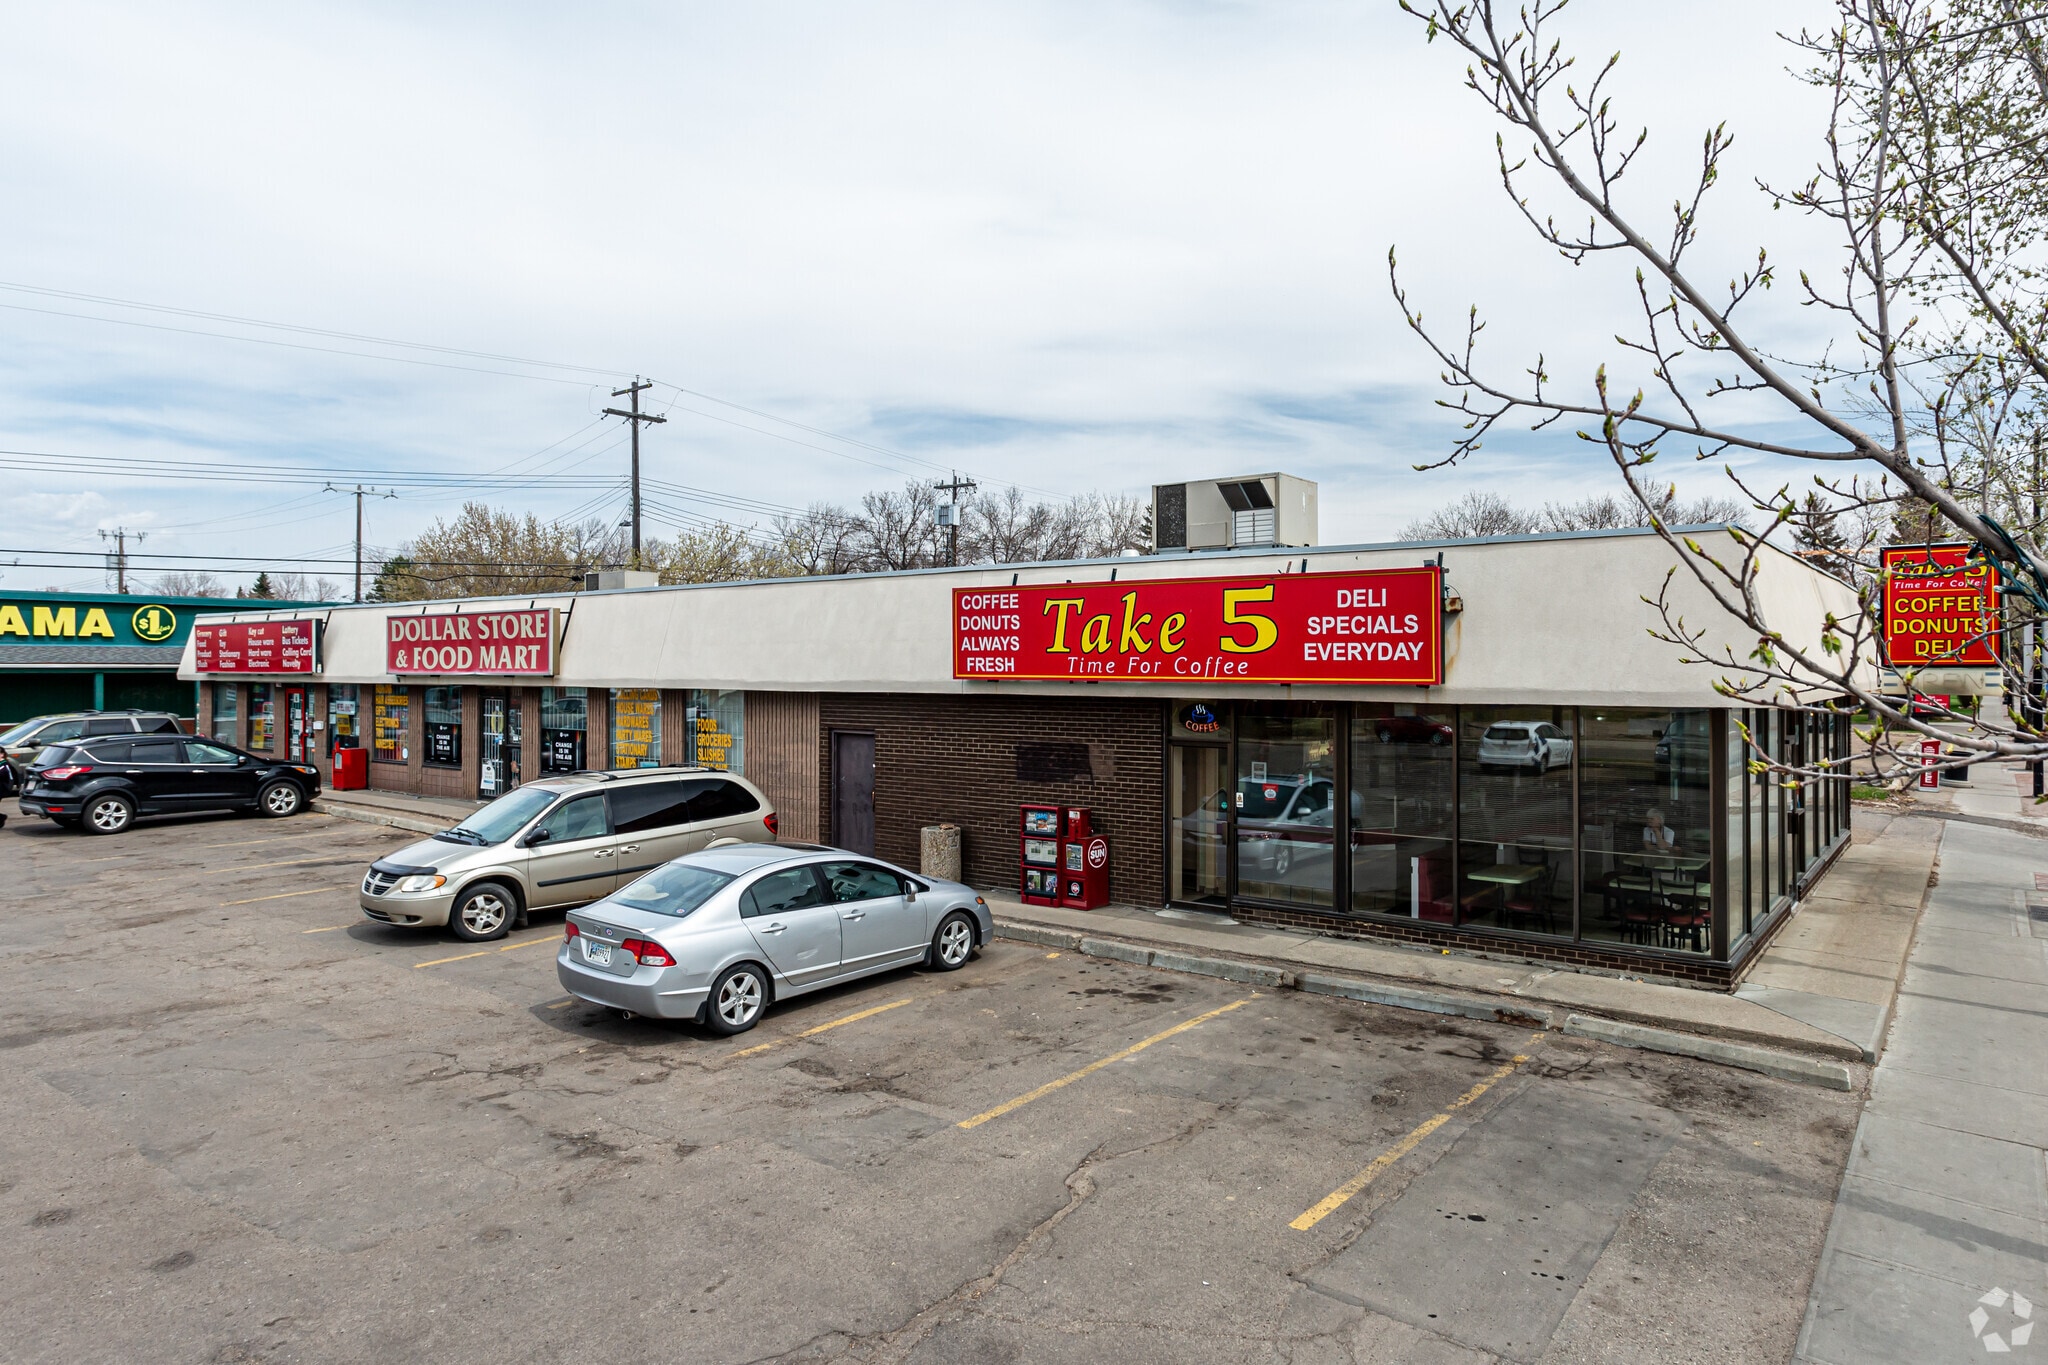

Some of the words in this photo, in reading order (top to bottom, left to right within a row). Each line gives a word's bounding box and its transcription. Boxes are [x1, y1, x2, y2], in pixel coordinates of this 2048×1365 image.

[1891, 561, 1956, 580] Take
[1964, 554, 1989, 578] 5
[1894, 581, 1921, 589] Time
[1926, 580, 1945, 588] For
[961, 593, 1019, 610] COFFEE
[1337, 588, 1387, 608] DELI
[1894, 596, 1987, 614] COFFEE
[0, 605, 115, 638] AMA
[960, 614, 1020, 631] DONUTS
[1042, 590, 1187, 655] Take
[1219, 583, 1279, 655] 5
[1307, 614, 1419, 635] SPECIALS
[1893, 617, 1989, 634] DONUTS
[248, 627, 256, 637] Key
[257, 627, 265, 635] cut
[282, 625, 299, 636] Lottery
[391, 616, 473, 642] DOLLAR
[477, 613, 547, 640] STORE
[248, 638, 262, 646] House
[282, 636, 291, 645] Bus
[291, 636, 309, 645] Tickets
[960, 636, 1020, 651] ALWAYS
[1914, 639, 1967, 655] DELI
[248, 648, 260, 657] Hard
[282, 648, 300, 659] Calling
[395, 649, 409, 669] &
[413, 646, 473, 670] FOOD
[479, 644, 541, 670] MART
[1304, 641, 1424, 661] EVERYDAY
[248, 659, 270, 667] Electronic
[282, 659, 302, 669] Novelty
[966, 657, 1015, 672] FRESH
[1067, 656, 1116, 674] Time
[1127, 656, 1162, 674] For
[1174, 656, 1249, 678] Coffee
[697, 718, 718, 732] FOODS
[1185, 719, 1220, 733] COFFEE
[697, 733, 732, 748] GROCERIES
[697, 747, 725, 762] SLUSHES
[1090, 848, 1105, 860] SUN
